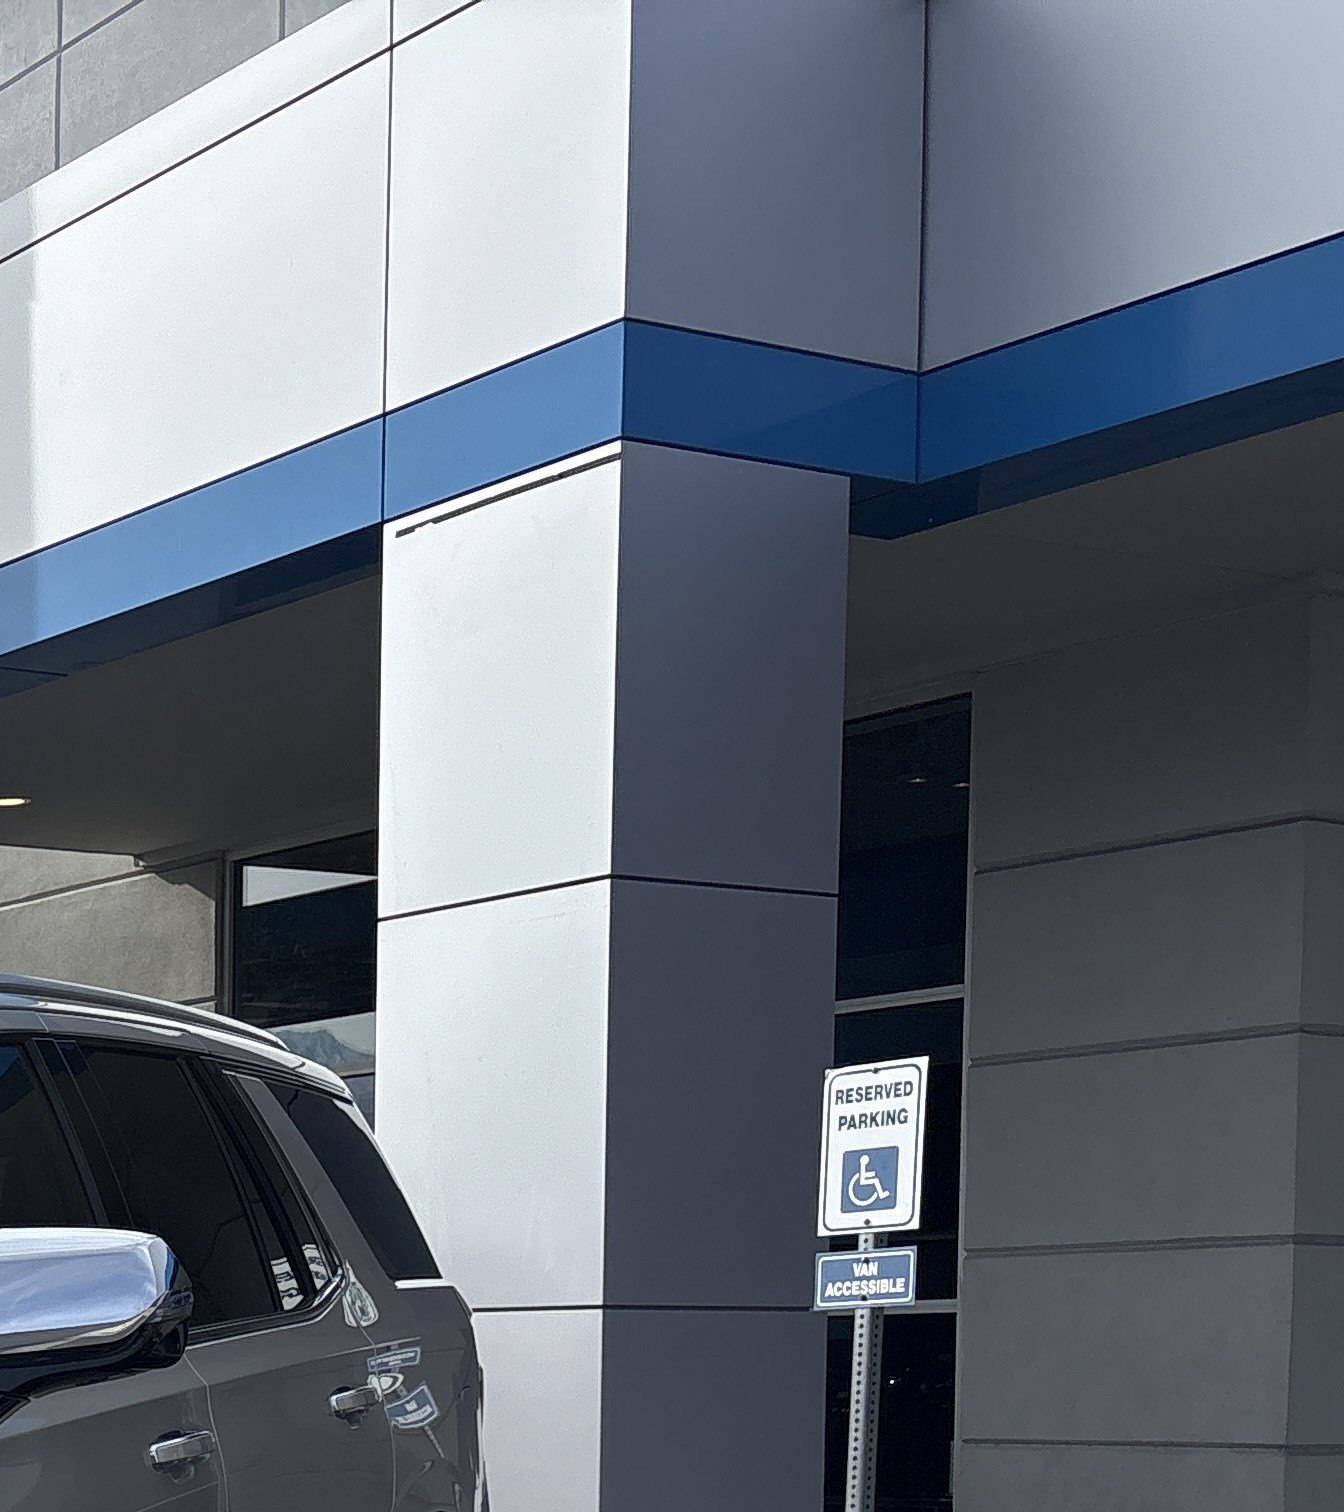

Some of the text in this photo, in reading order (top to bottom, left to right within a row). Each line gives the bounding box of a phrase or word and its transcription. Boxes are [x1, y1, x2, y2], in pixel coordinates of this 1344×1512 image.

[835, 1080, 914, 1106] RESERVED
[838, 1108, 909, 1132] PARKING
[853, 1261, 879, 1277] VAN
[825, 1277, 905, 1297] ACCESSIBLE
